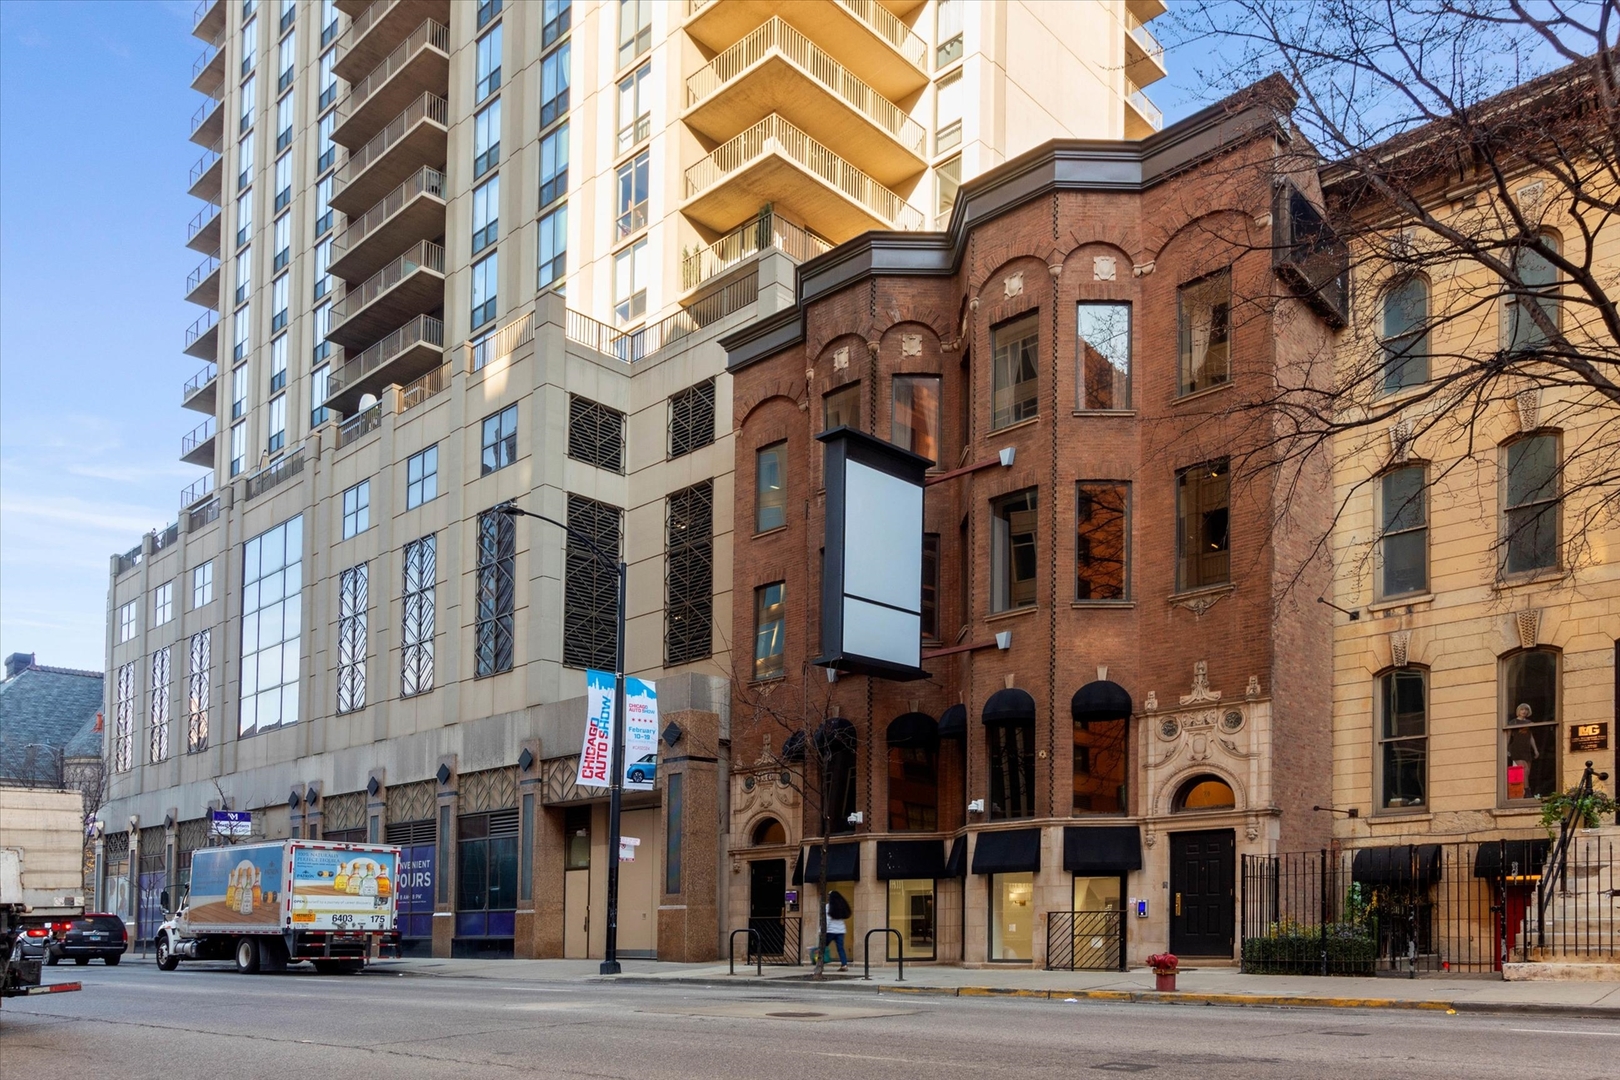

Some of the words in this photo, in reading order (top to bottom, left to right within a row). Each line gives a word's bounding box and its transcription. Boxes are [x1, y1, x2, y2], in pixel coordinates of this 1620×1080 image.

[598, 696, 611, 740] SHOW
[628, 726, 656, 734] February
[582, 718, 600, 779] CHICAGO
[594, 742, 608, 780] AUTO
[400, 860, 430, 870] NVENIENT
[400, 872, 432, 888] OURS
[332, 914, 353, 922] 6403
